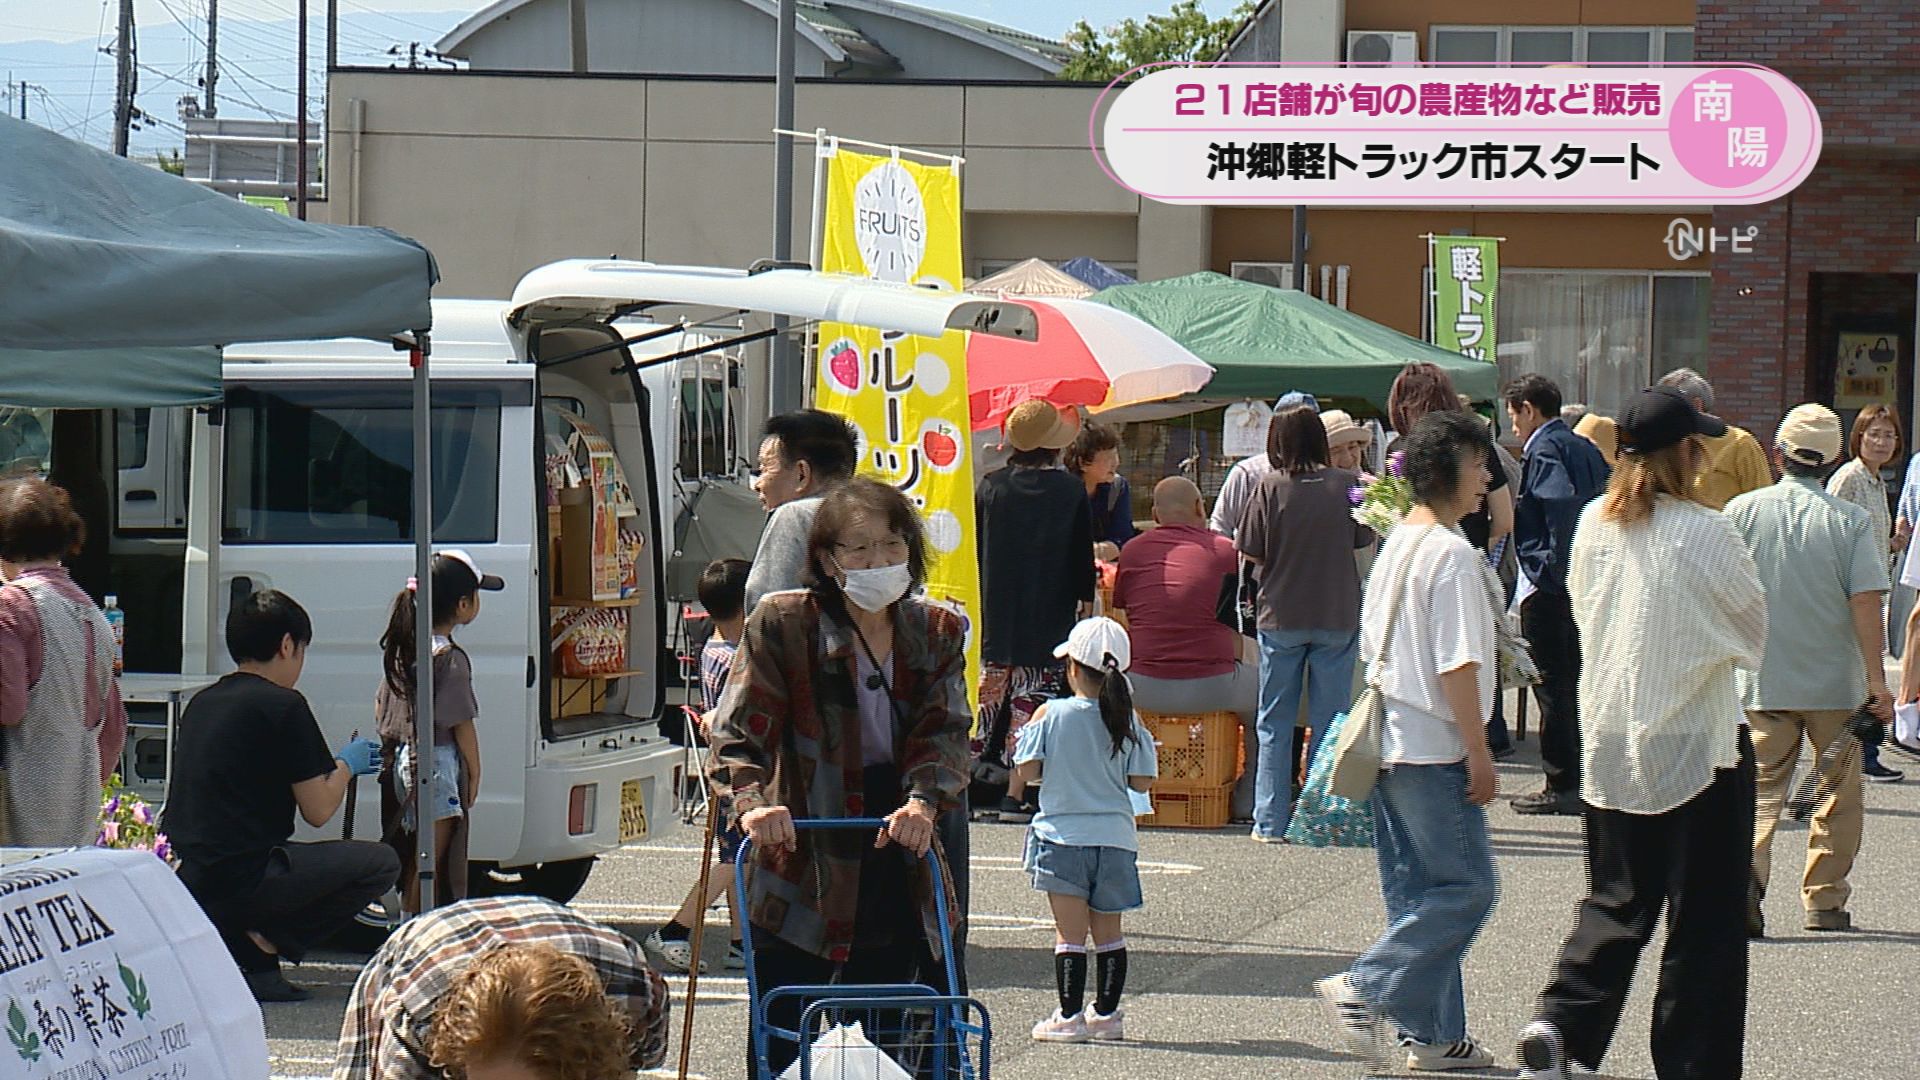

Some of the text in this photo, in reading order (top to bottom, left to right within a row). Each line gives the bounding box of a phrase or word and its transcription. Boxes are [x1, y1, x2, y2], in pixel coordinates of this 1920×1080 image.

[859, 208, 921, 242] FRUITS
[36, 890, 115, 952] TEA
[34, 976, 128, 1059] 桑の葉茶
